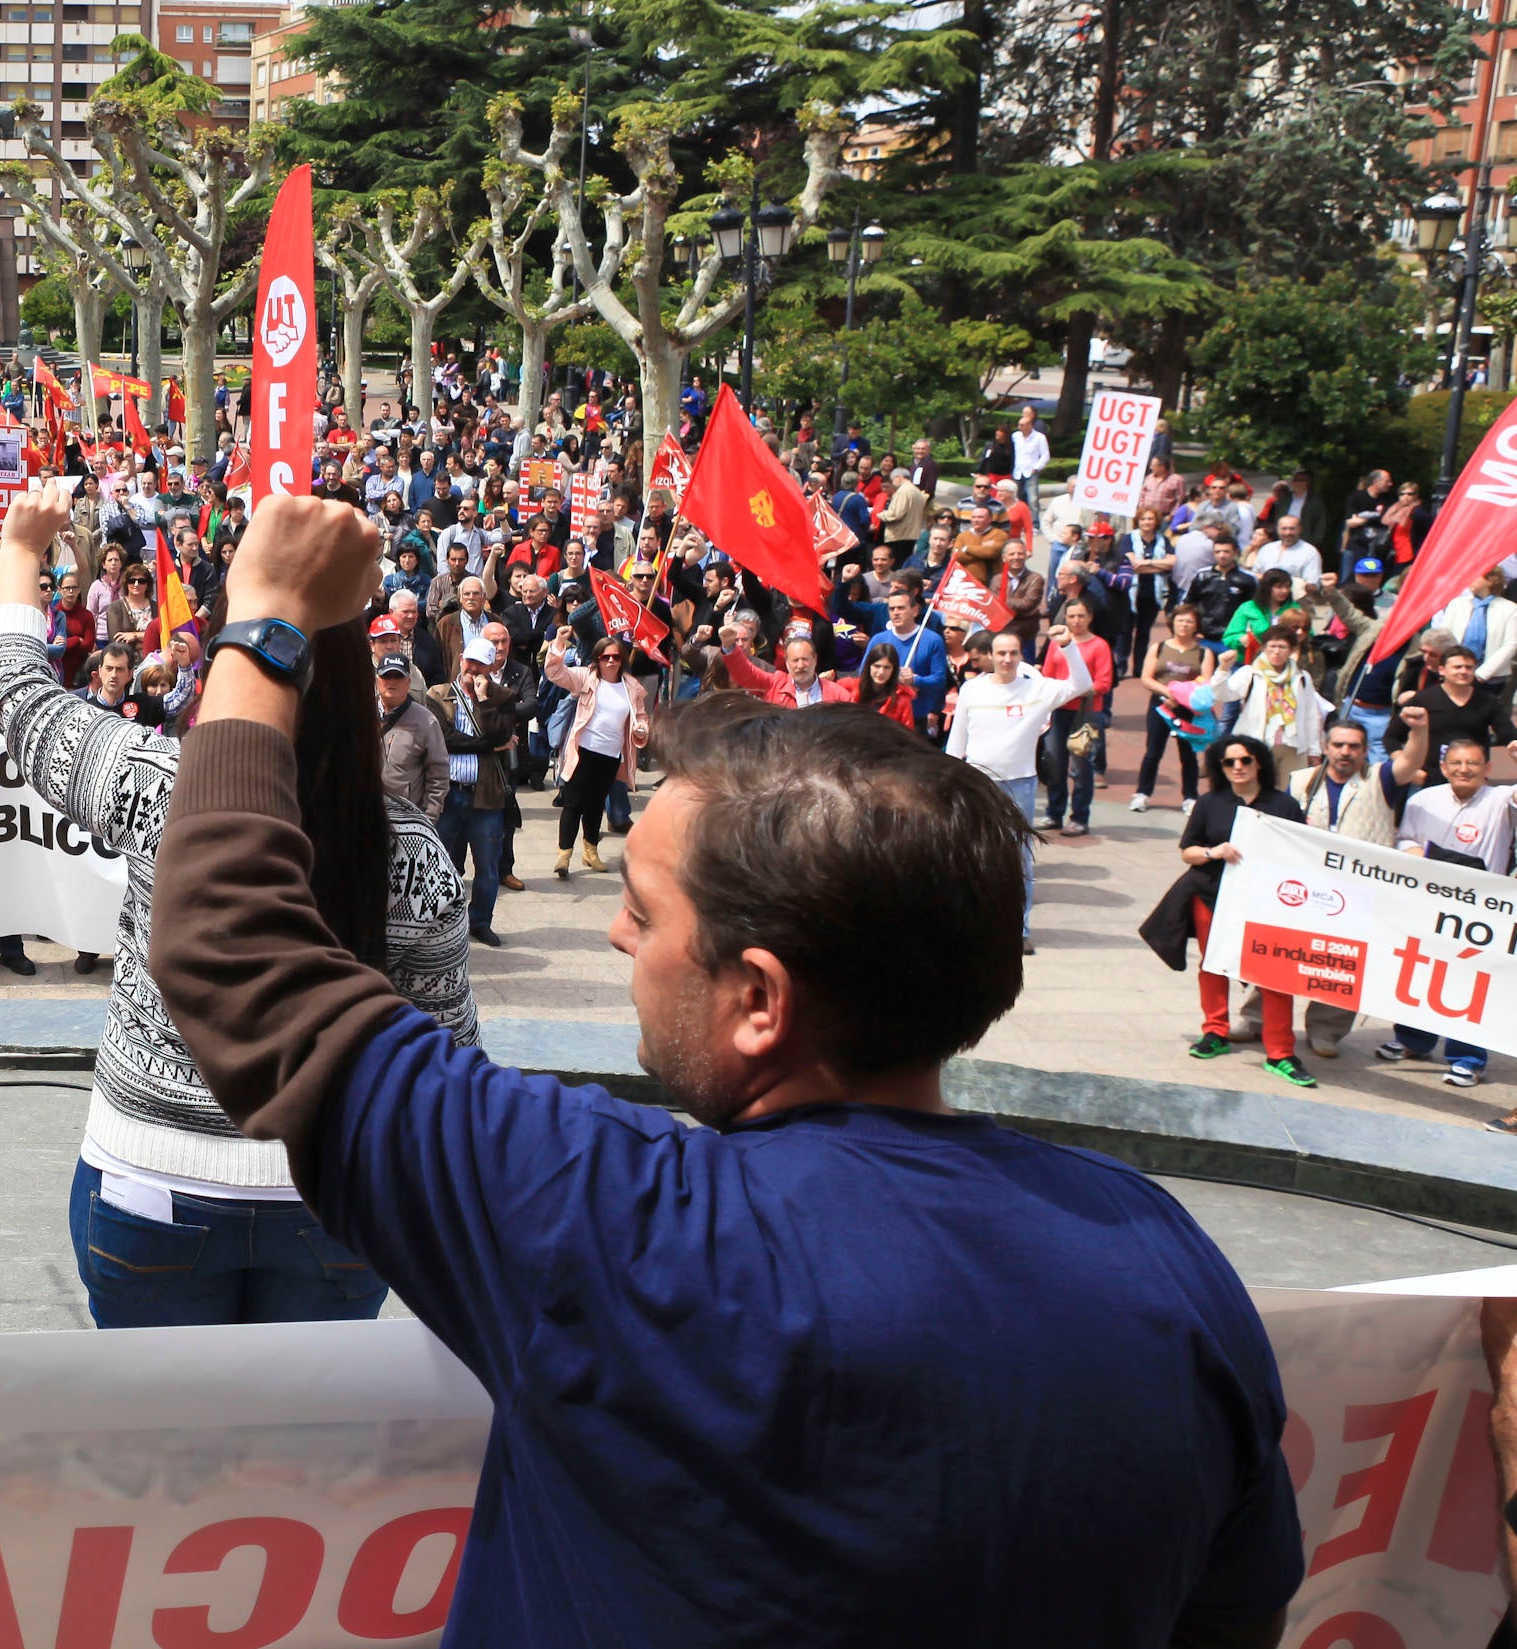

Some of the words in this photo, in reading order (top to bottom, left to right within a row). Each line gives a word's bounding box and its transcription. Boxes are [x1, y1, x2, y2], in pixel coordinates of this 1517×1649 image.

[1098, 397, 1153, 427] UGT
[1092, 426, 1146, 457] UGT
[1086, 455, 1139, 485] UGT
[1312, 890, 1334, 902] MCA
[1325, 852, 1343, 870] El
[1352, 859, 1418, 889] futuro
[1426, 882, 1476, 905] está
[1484, 896, 1514, 915] en
[1435, 911, 1493, 946] no
[1251, 939, 1267, 956] la
[1272, 943, 1357, 972] industria
[1311, 938, 1325, 952] El
[1327, 942, 1359, 958] 29M
[1298, 963, 1356, 984] también
[1307, 976, 1353, 996] para
[1393, 935, 1491, 1025] tú
